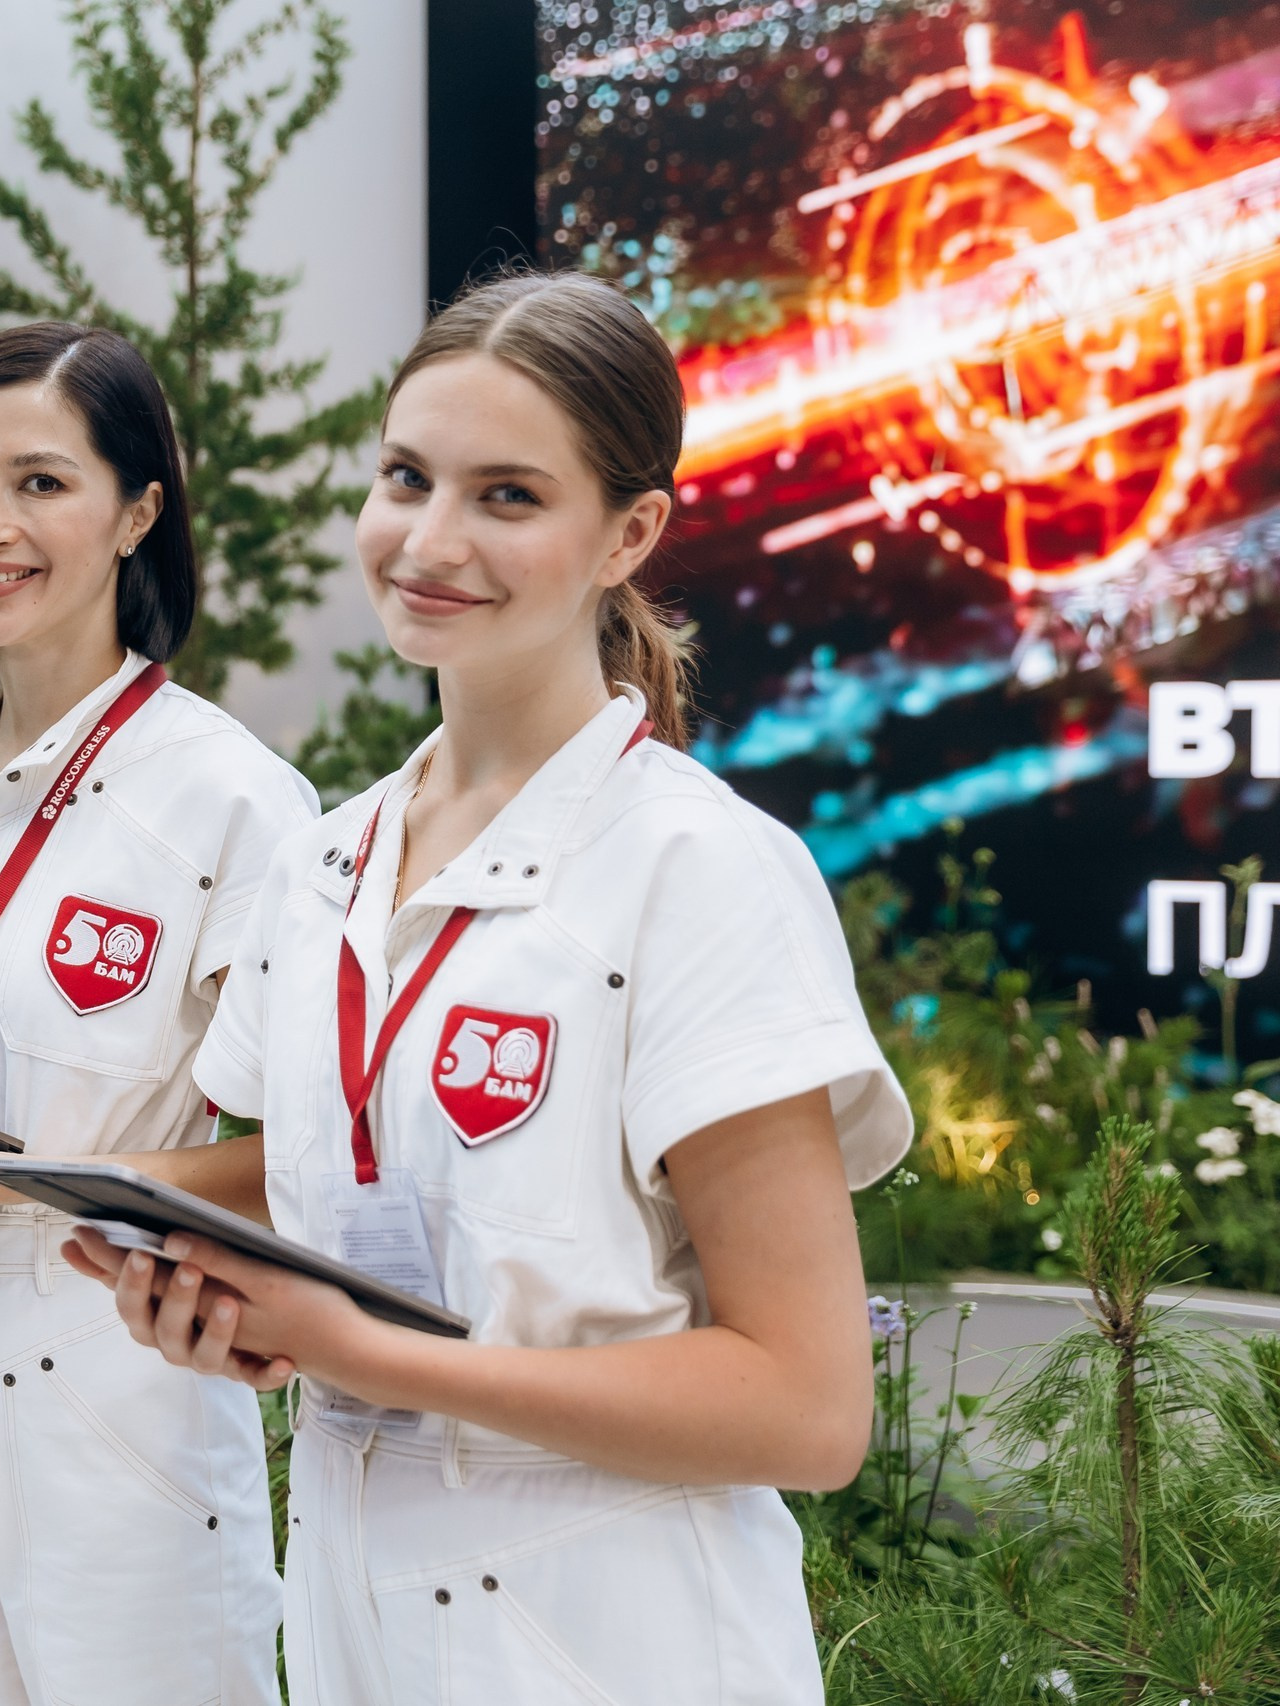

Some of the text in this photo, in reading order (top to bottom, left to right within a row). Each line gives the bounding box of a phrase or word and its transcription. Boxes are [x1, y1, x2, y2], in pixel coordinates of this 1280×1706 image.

[49, 724, 111, 807] ROSCONGRESS
[93, 961, 136, 985] БАМ
[483, 1076, 533, 1103] БАМ
